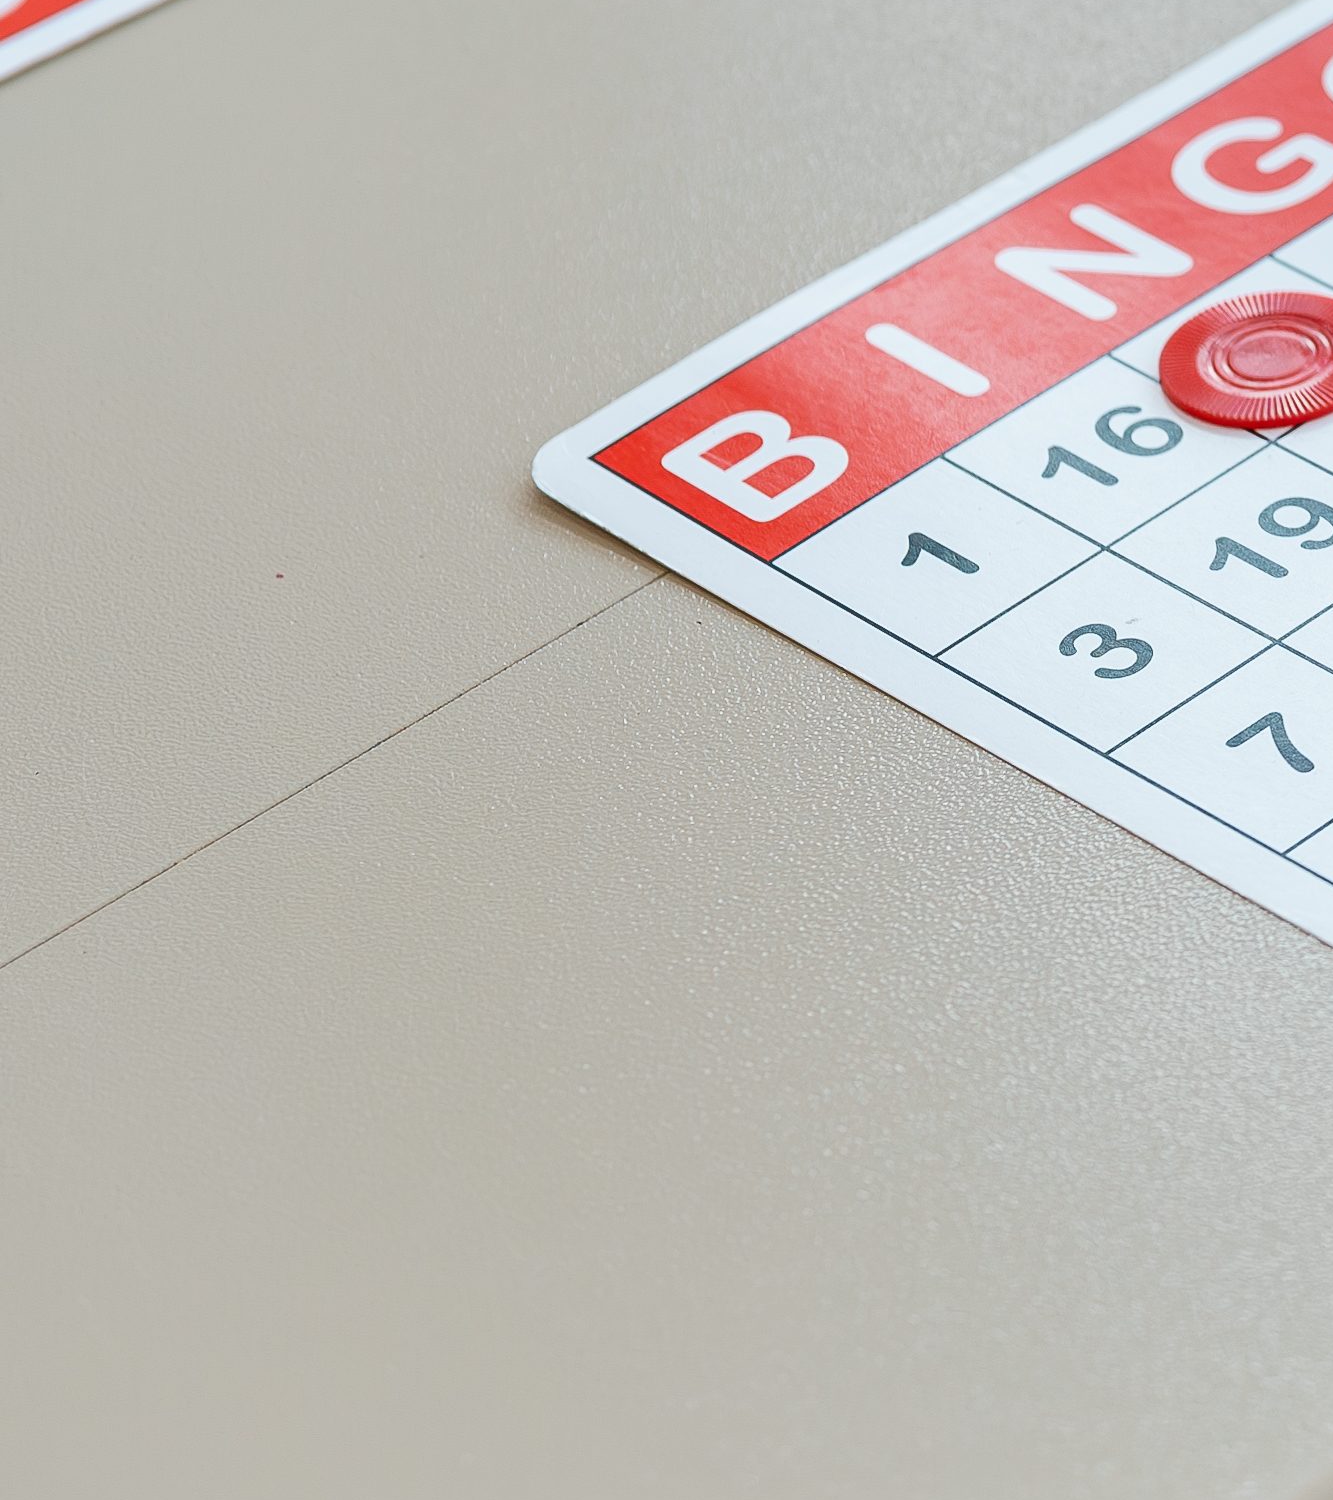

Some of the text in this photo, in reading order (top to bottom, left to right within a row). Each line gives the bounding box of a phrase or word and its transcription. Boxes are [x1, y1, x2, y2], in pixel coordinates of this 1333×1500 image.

[899, 530, 981, 576] 1
[1038, 404, 1186, 489] 16
[1056, 621, 1156, 682] 3
[1224, 709, 1317, 776] 7
